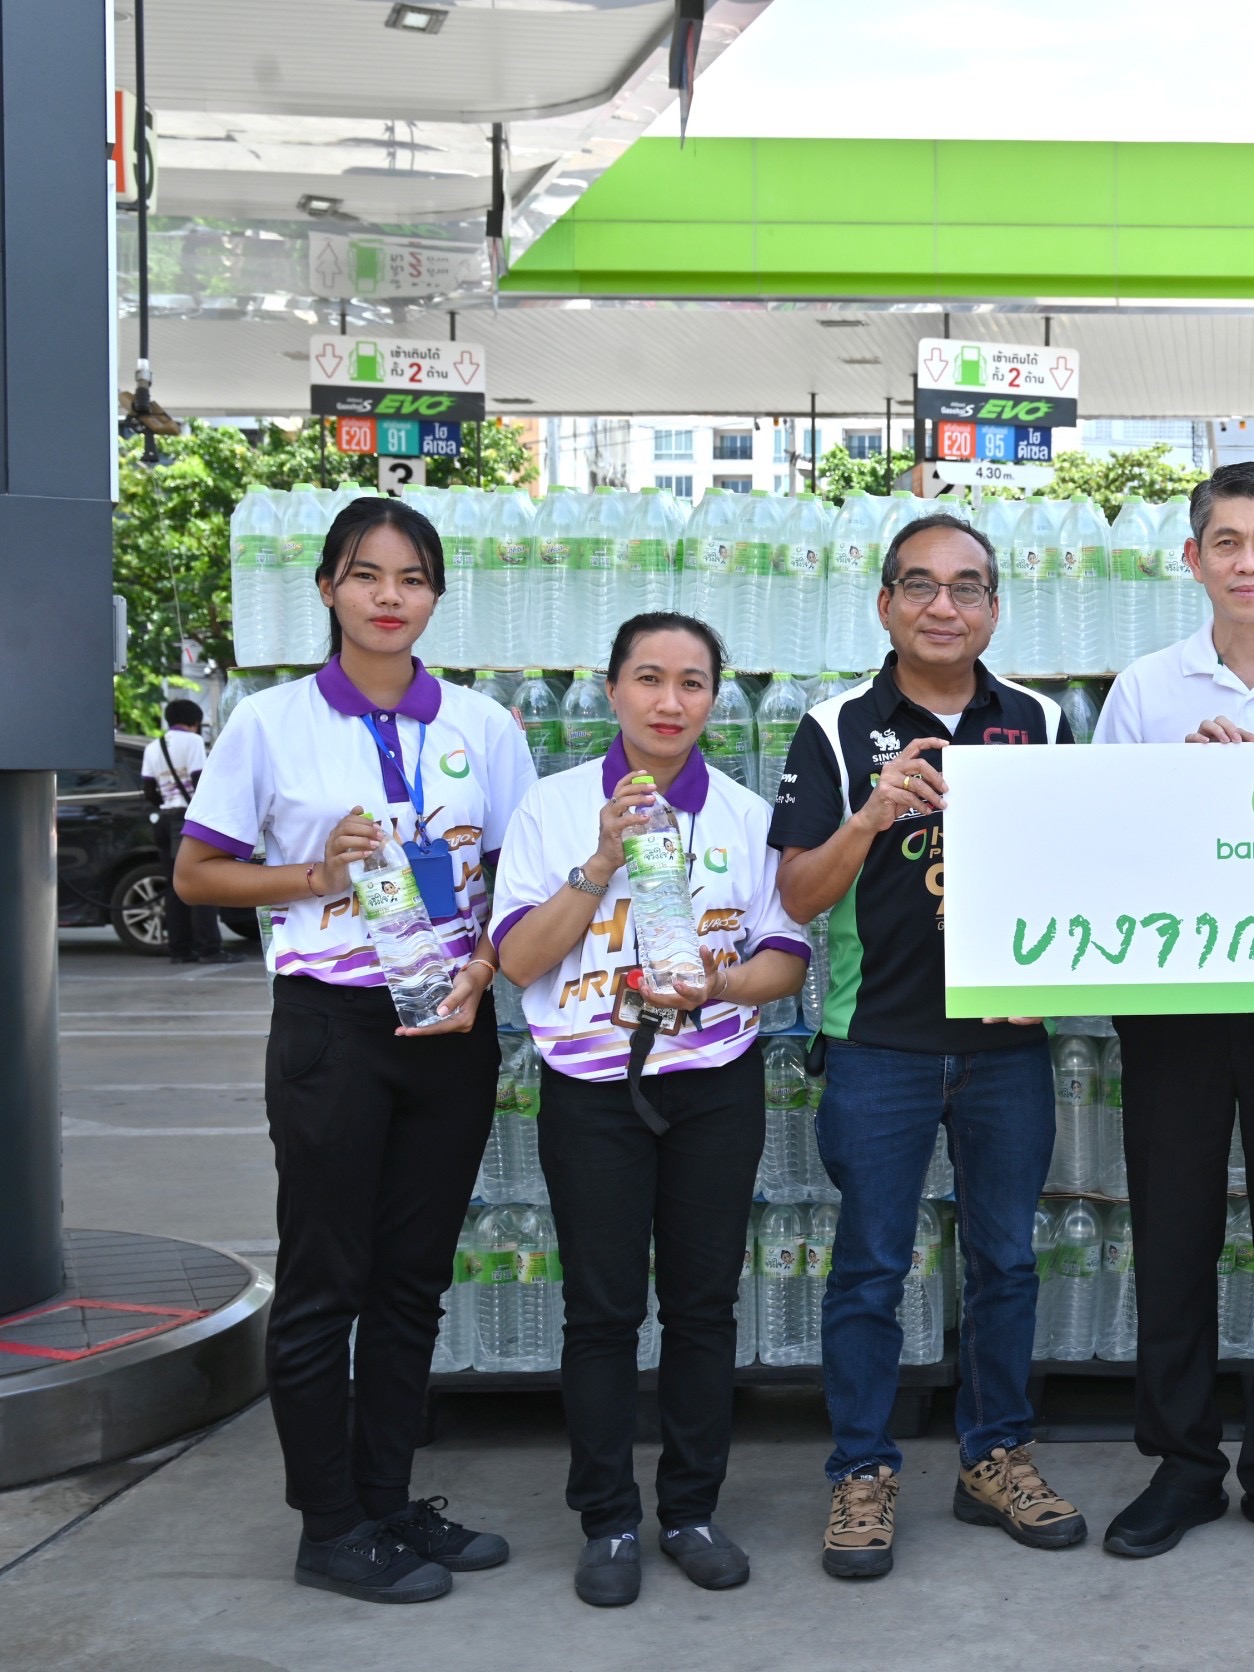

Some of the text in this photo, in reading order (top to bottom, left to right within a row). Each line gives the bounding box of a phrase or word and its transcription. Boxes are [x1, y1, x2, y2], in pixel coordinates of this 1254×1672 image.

[408, 362, 423, 383] 2
[1008, 367, 1021, 387] 2
[375, 393, 456, 415] EVO
[977, 398, 1052, 421] EVO
[341, 427, 371, 450] E20
[388, 429, 406, 452] 91
[423, 435, 457, 455] ดีเซล
[944, 432, 971, 455] E20
[985, 434, 1005, 457] 95
[1018, 441, 1048, 460] ดีเซล
[388, 463, 414, 496] 3
[976, 467, 1002, 480] 4.30
